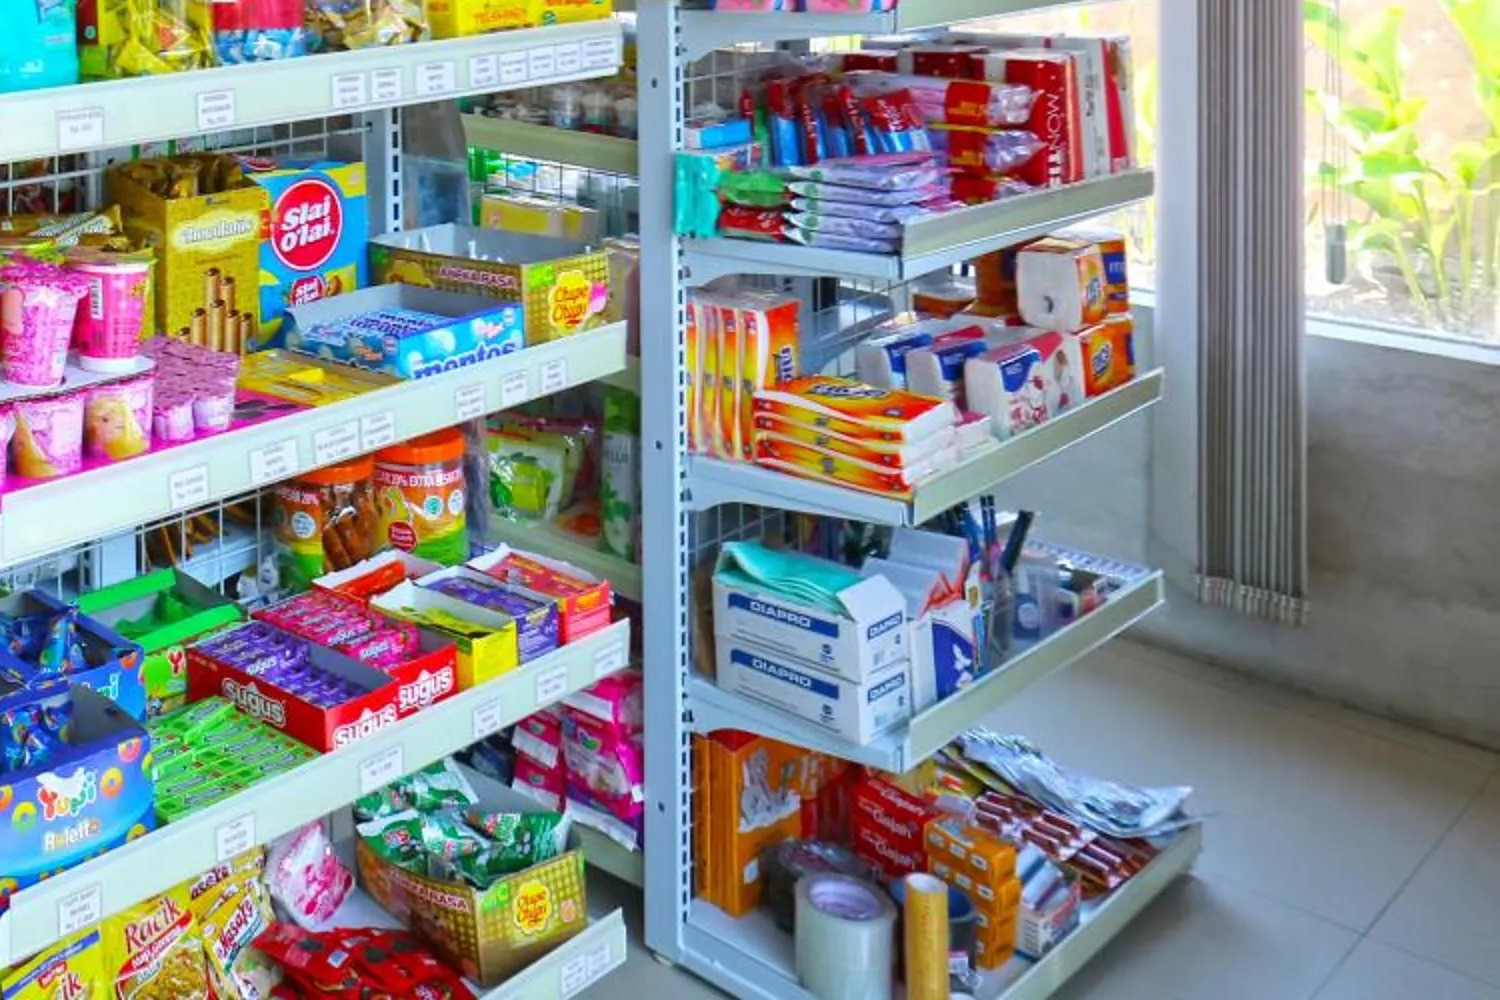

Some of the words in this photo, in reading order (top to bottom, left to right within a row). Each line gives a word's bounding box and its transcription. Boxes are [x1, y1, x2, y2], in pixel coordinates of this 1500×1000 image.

[281, 194, 332, 231] Slai
[413, 342, 518, 379] mentos
[224, 679, 286, 727] sugus
[399, 665, 453, 711] sugus
[334, 702, 397, 749] sugus
[125, 897, 182, 954] Racik
